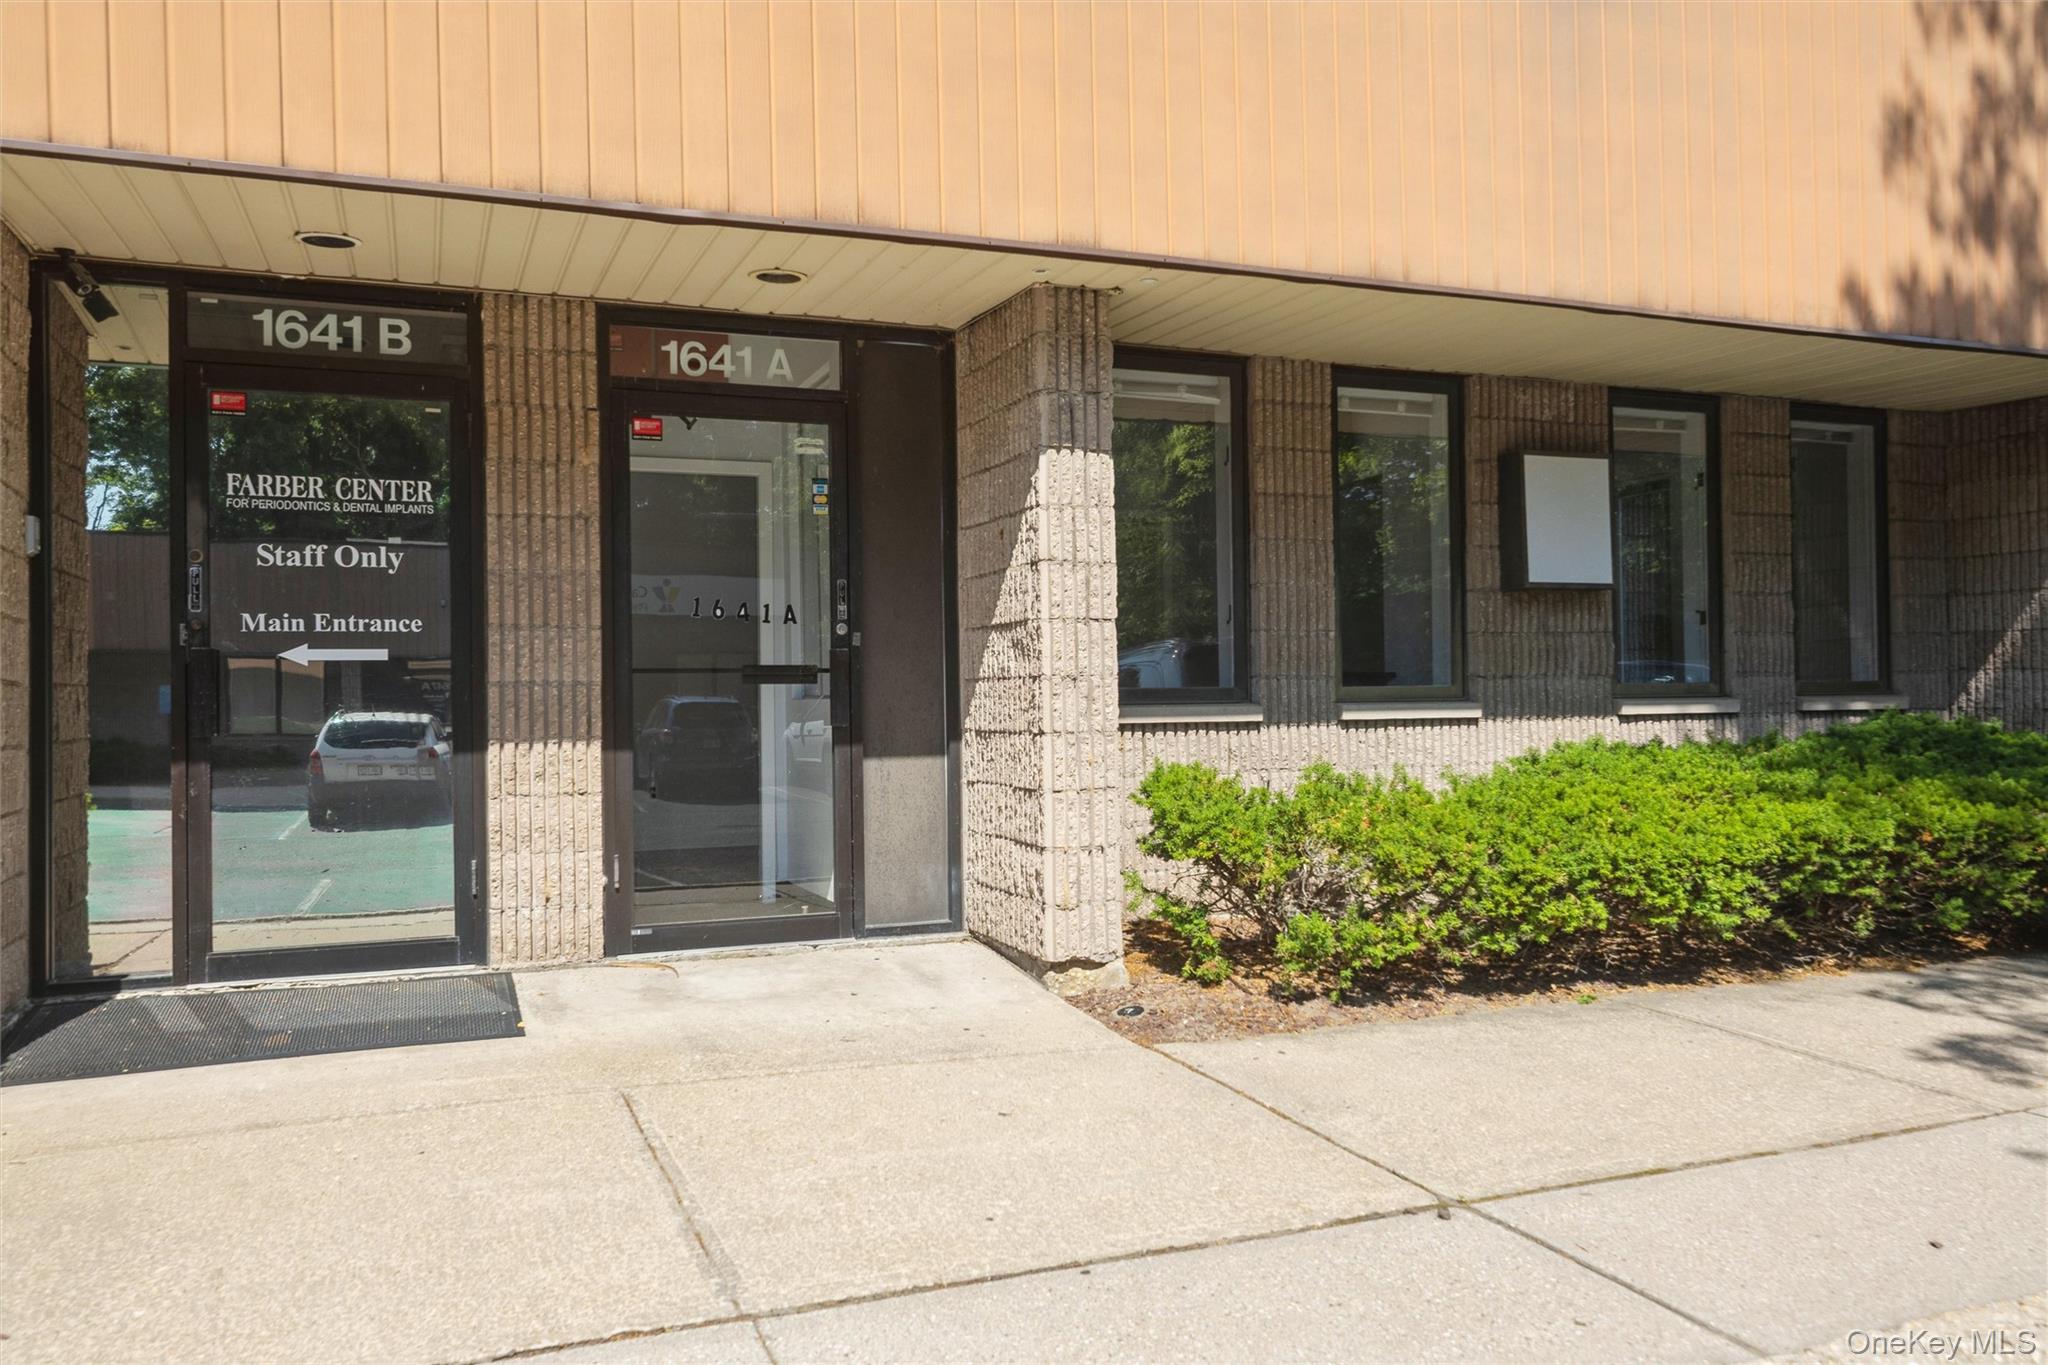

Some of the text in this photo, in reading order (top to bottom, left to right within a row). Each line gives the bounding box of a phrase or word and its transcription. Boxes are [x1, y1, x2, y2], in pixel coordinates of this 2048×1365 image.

[252, 308, 413, 356] 1641 B
[661, 339, 794, 382] 1641 A
[226, 473, 434, 503] FARBER CENTER
[226, 497, 435, 515] FOR PERIODONTICS & DENTAL IMPLANTS
[256, 542, 404, 574] Staff Only
[240, 612, 424, 633] Main Entrance
